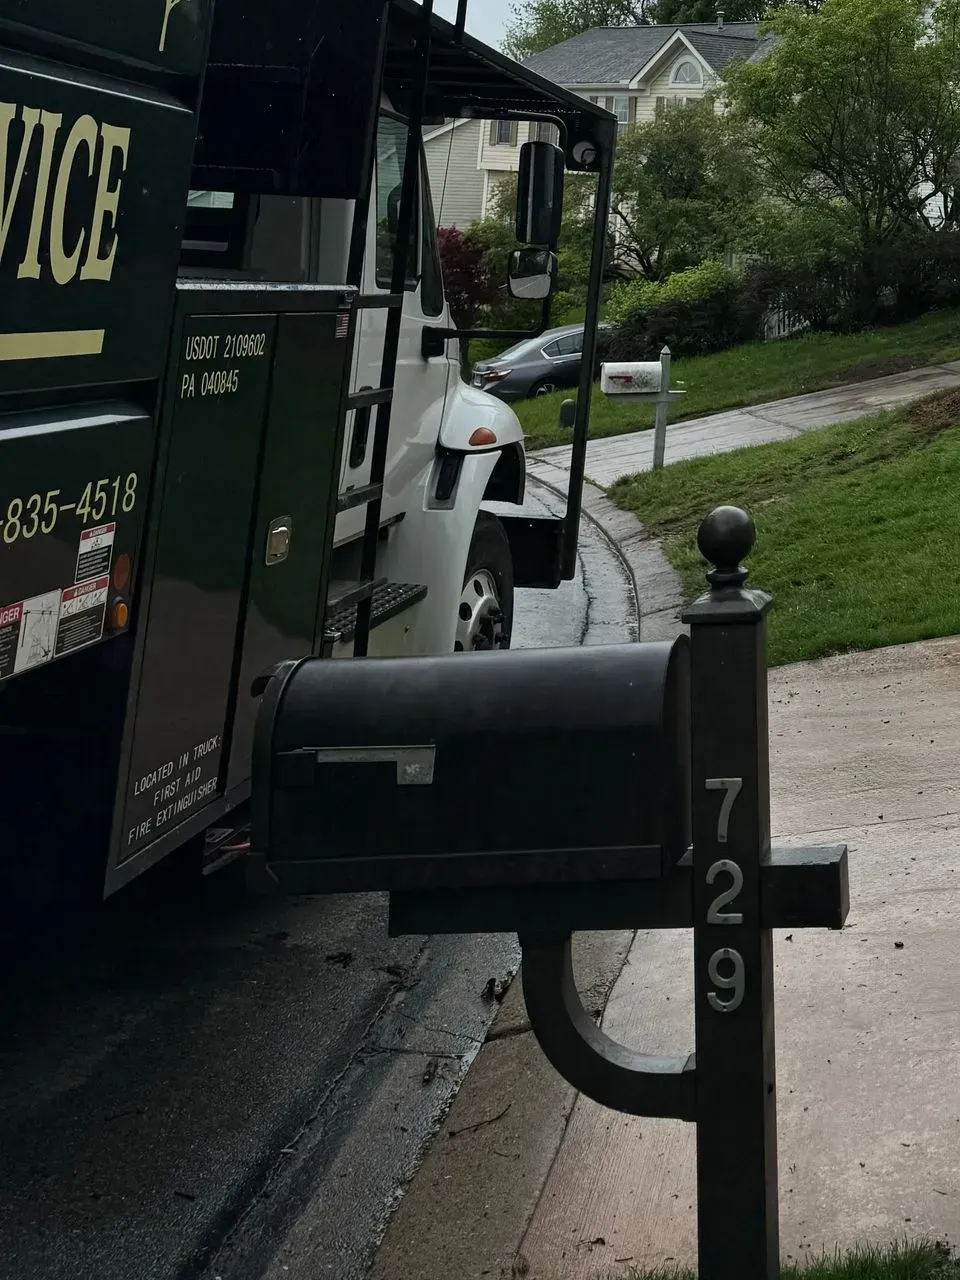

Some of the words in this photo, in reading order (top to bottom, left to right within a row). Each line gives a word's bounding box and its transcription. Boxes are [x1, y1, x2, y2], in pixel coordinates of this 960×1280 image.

[185, 335, 220, 361] USDOT
[223, 333, 266, 358] 2109602
[180, 372, 195, 399] PA
[201, 369, 240, 396] 040845
[0, 472, 138, 544] 835-4518
[77, 582, 97, 597] DANGER
[134, 761, 174, 796] LOCATED
[178, 751, 189, 769] IN
[153, 778, 182, 807] FIRST
[185, 766, 202, 788] AID
[127, 818, 152, 845] FIRE
[156, 776, 218, 827] EXTINGUISHER
